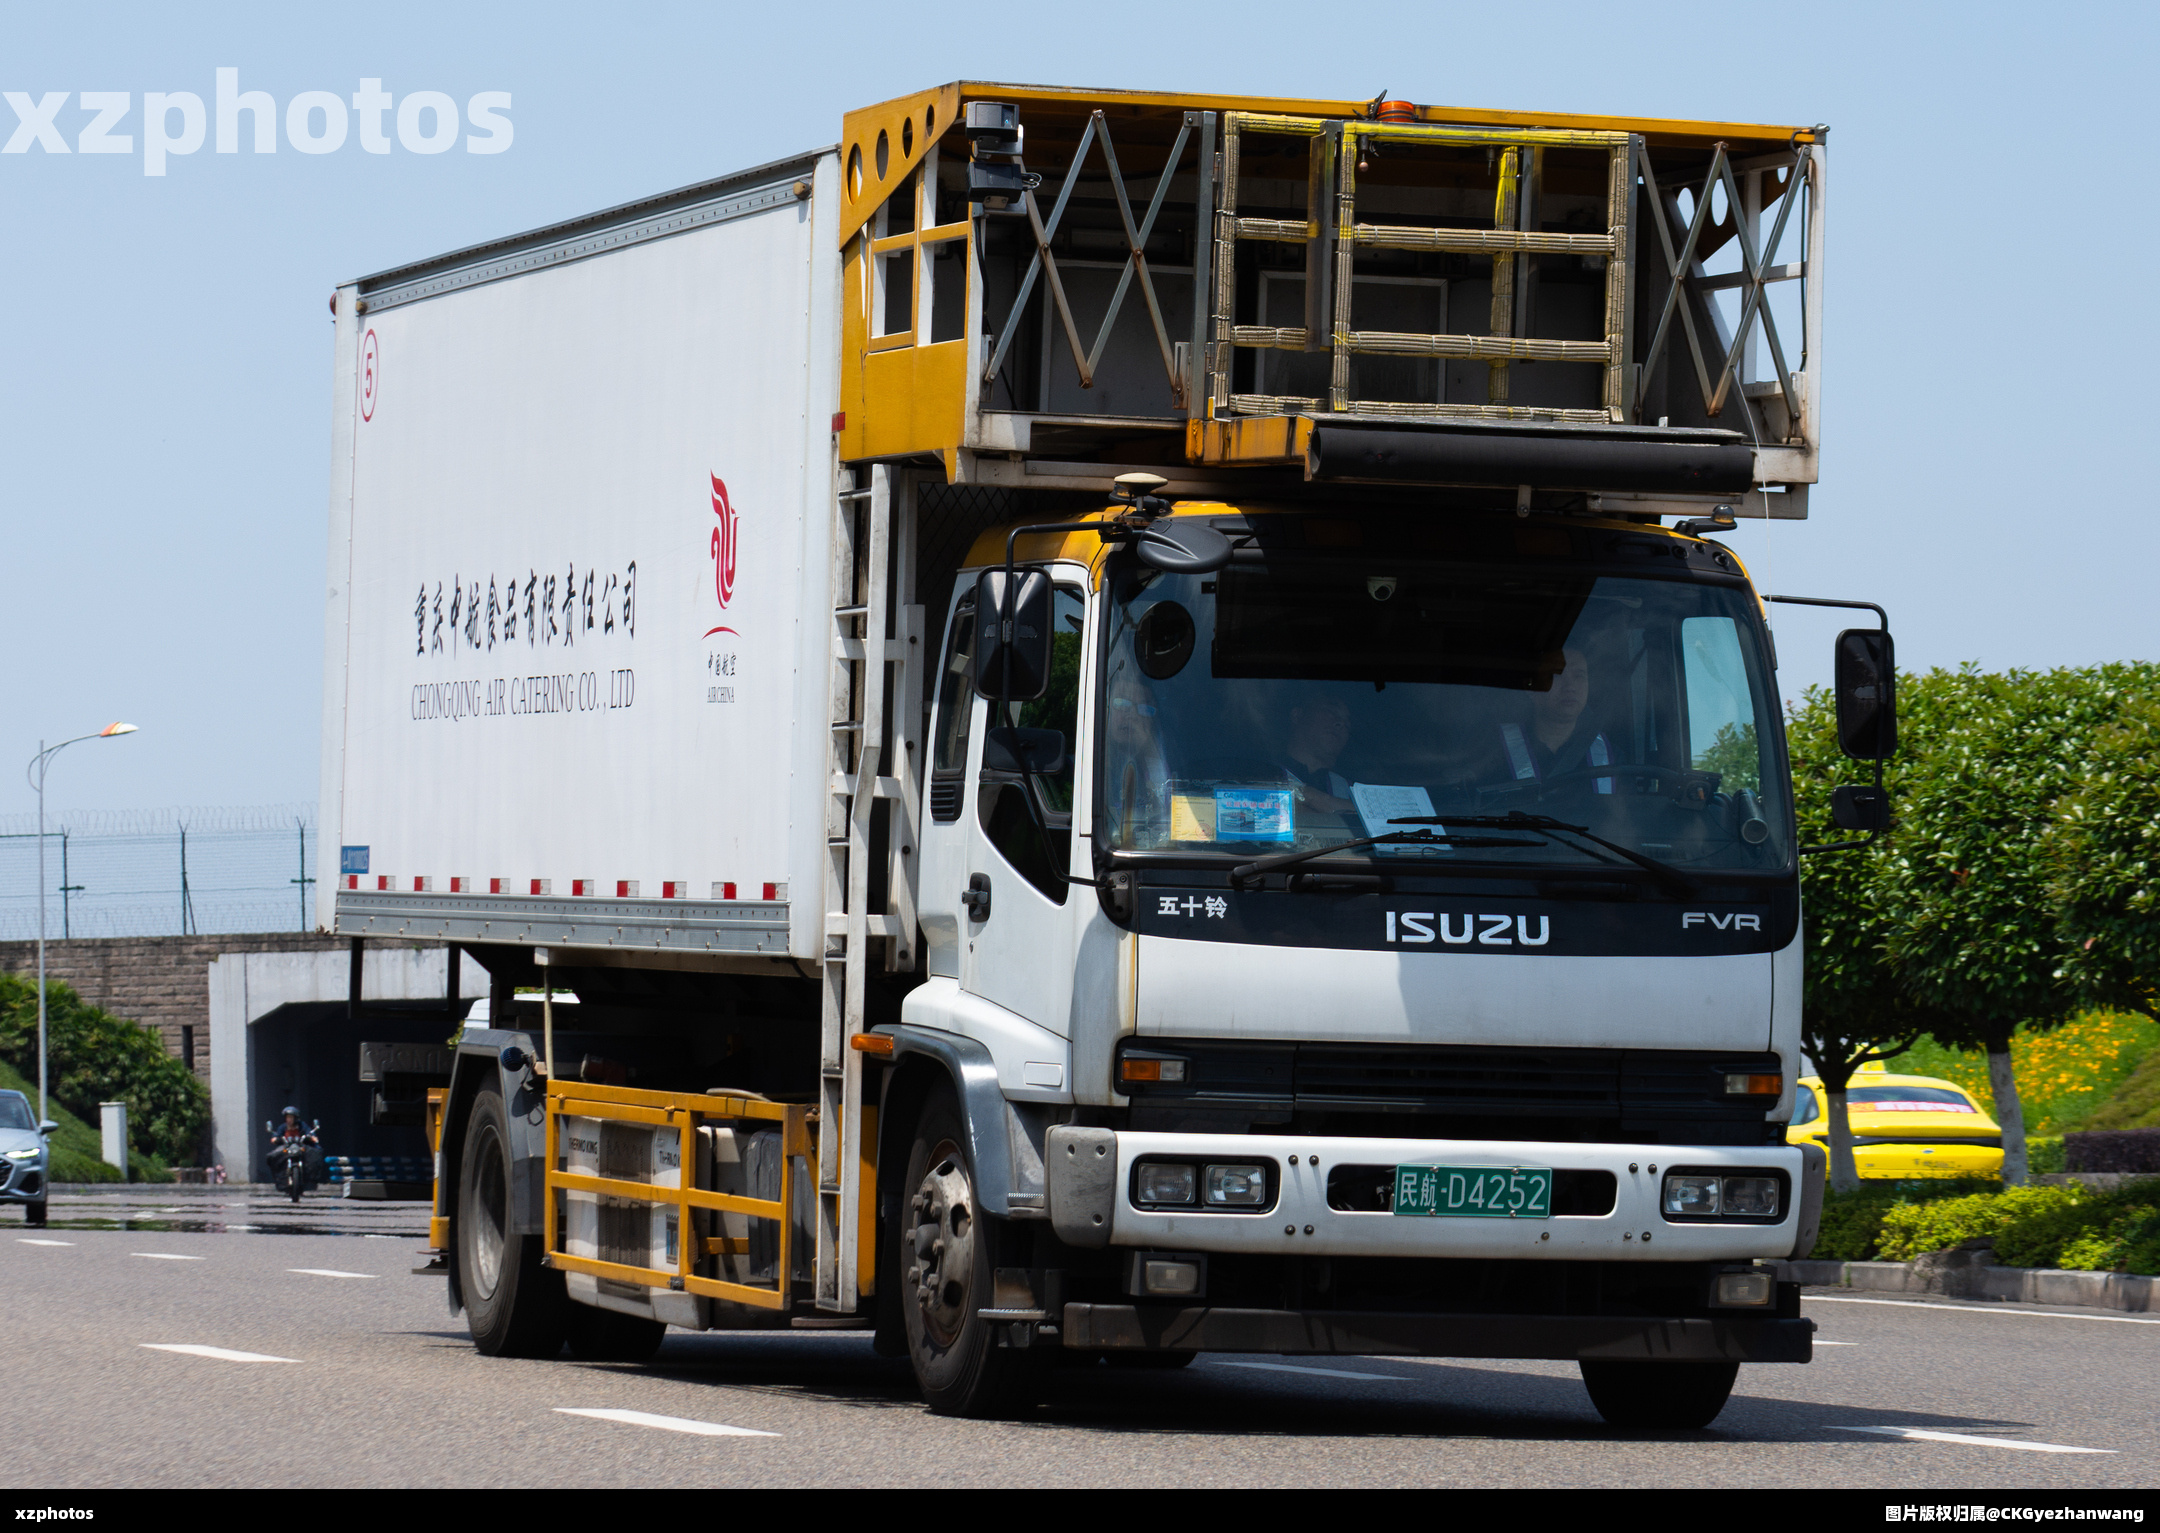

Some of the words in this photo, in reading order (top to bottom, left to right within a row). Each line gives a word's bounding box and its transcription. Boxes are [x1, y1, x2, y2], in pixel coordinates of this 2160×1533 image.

[365, 352, 373, 399] 5
[414, 560, 636, 661] 重庆中航食品有限责任公司
[411, 680, 481, 722] CHONGQING
[484, 678, 506, 716] AIR
[510, 673, 574, 715] CATERING
[609, 668, 635, 709] LTD
[1157, 895, 1228, 919] 五十铃
[1682, 912, 1761, 931] FVR
[1386, 911, 1549, 945] ISUZU
[1400, 1172, 1546, 1210] 民航-D4252
